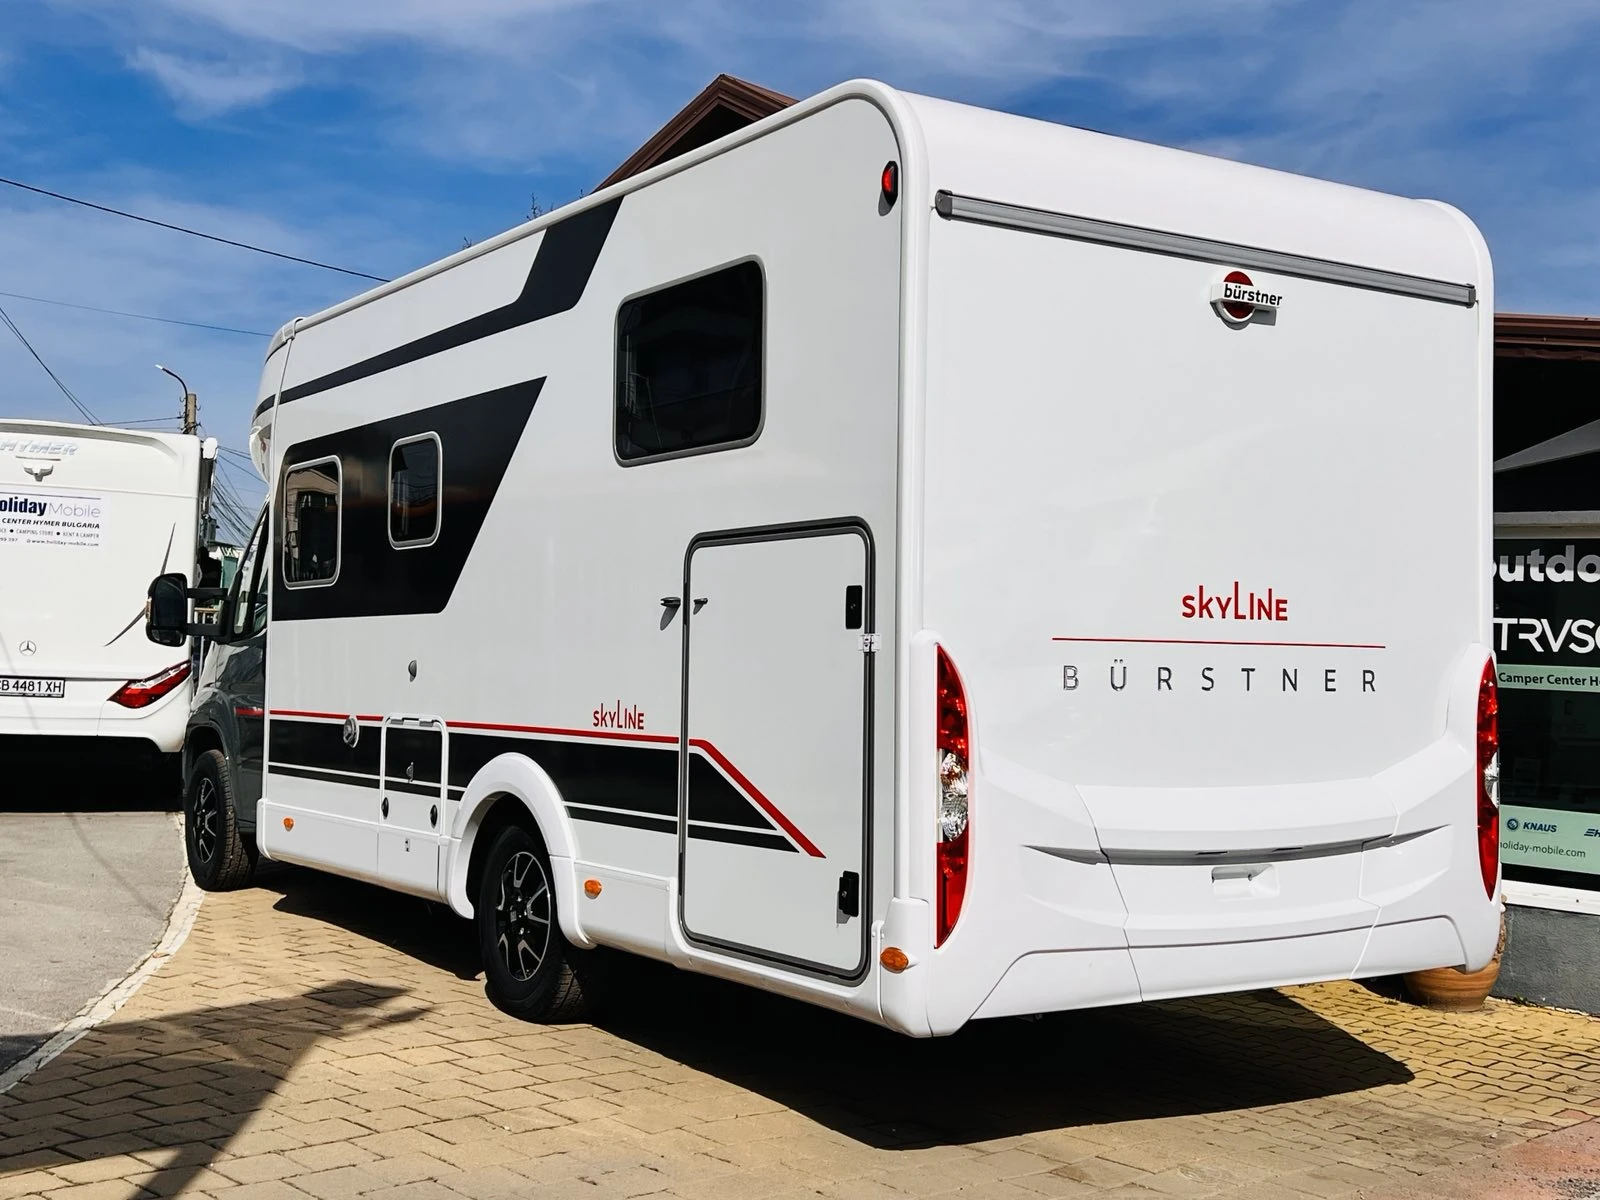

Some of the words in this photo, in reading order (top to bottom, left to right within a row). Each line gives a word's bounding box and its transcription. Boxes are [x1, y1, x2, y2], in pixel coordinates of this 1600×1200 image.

[1224, 284, 1282, 306] bürstner
[49, 503, 101, 518] Mobile
[62, 521, 100, 529] BULGARIA
[1493, 545, 1600, 582] utdo
[1493, 617, 1600, 653] TRVS
[1063, 659, 1376, 692] BÜRSTNER
[1498, 673, 1544, 685] Camper
[1546, 675, 1587, 686] Center
[1590, 676, 1600, 686] H
[0, 680, 9, 691] B
[12, 680, 41, 692] 4481
[45, 681, 61, 693] XH
[1523, 822, 1557, 833] KNAUS
